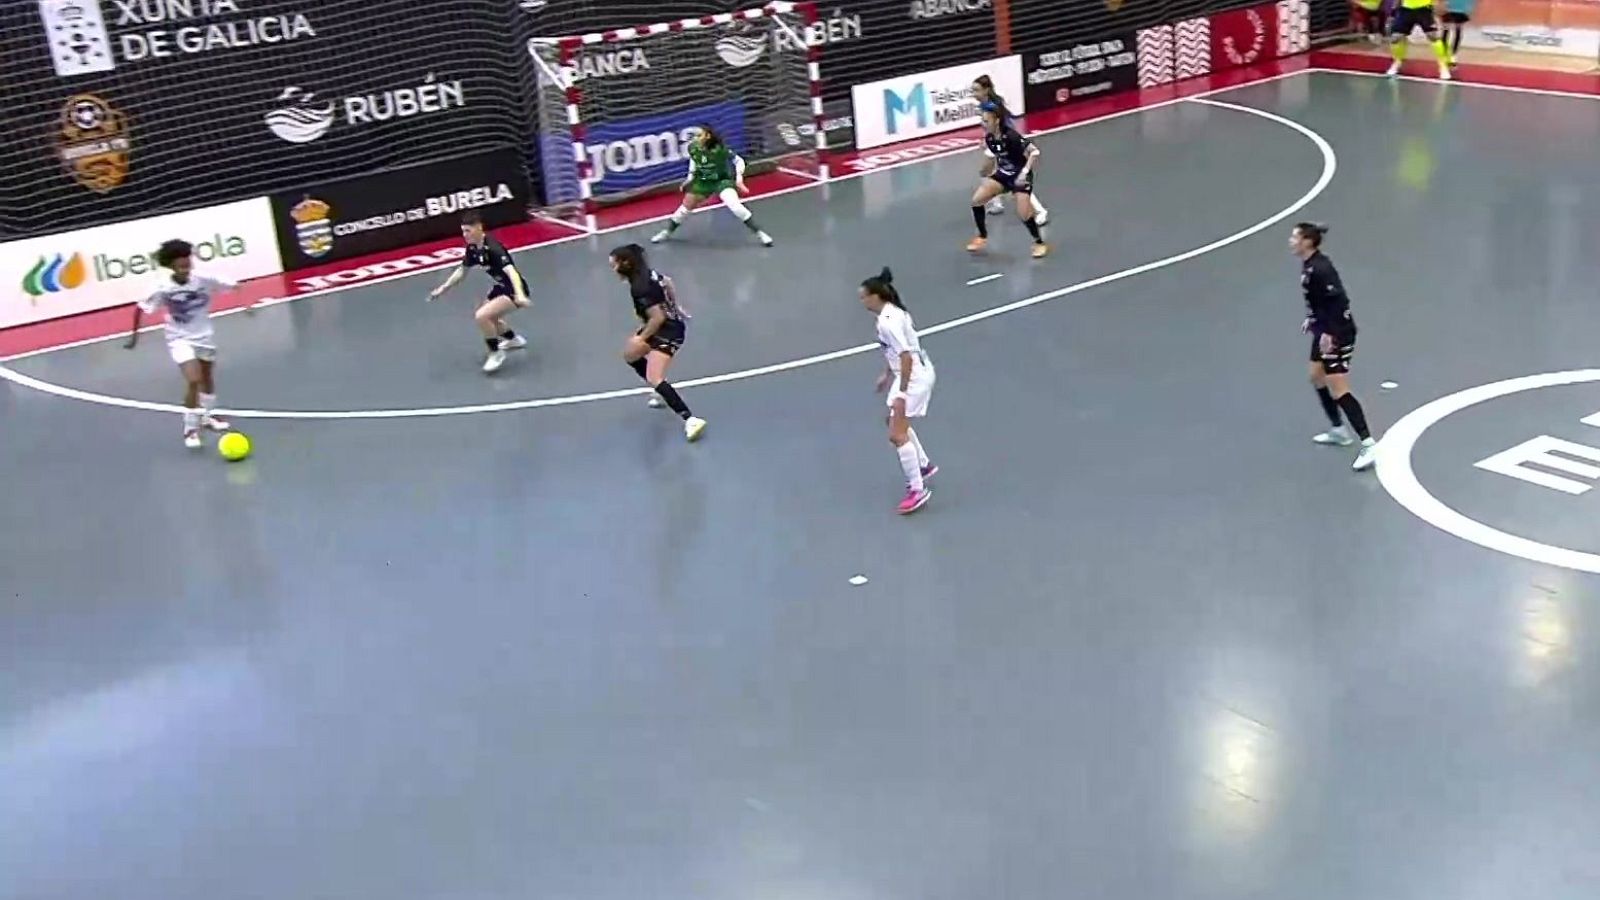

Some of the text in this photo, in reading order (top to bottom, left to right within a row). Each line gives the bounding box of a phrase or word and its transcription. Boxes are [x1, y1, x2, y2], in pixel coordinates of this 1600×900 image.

[115, 0, 240, 25] XUNTA
[120, 14, 317, 61] DE GALICIA
[560, 47, 650, 81] BANCA
[344, 71, 466, 125] RUBÉN
[425, 183, 514, 217] BURELA
[93, 233, 247, 282] Iberola
